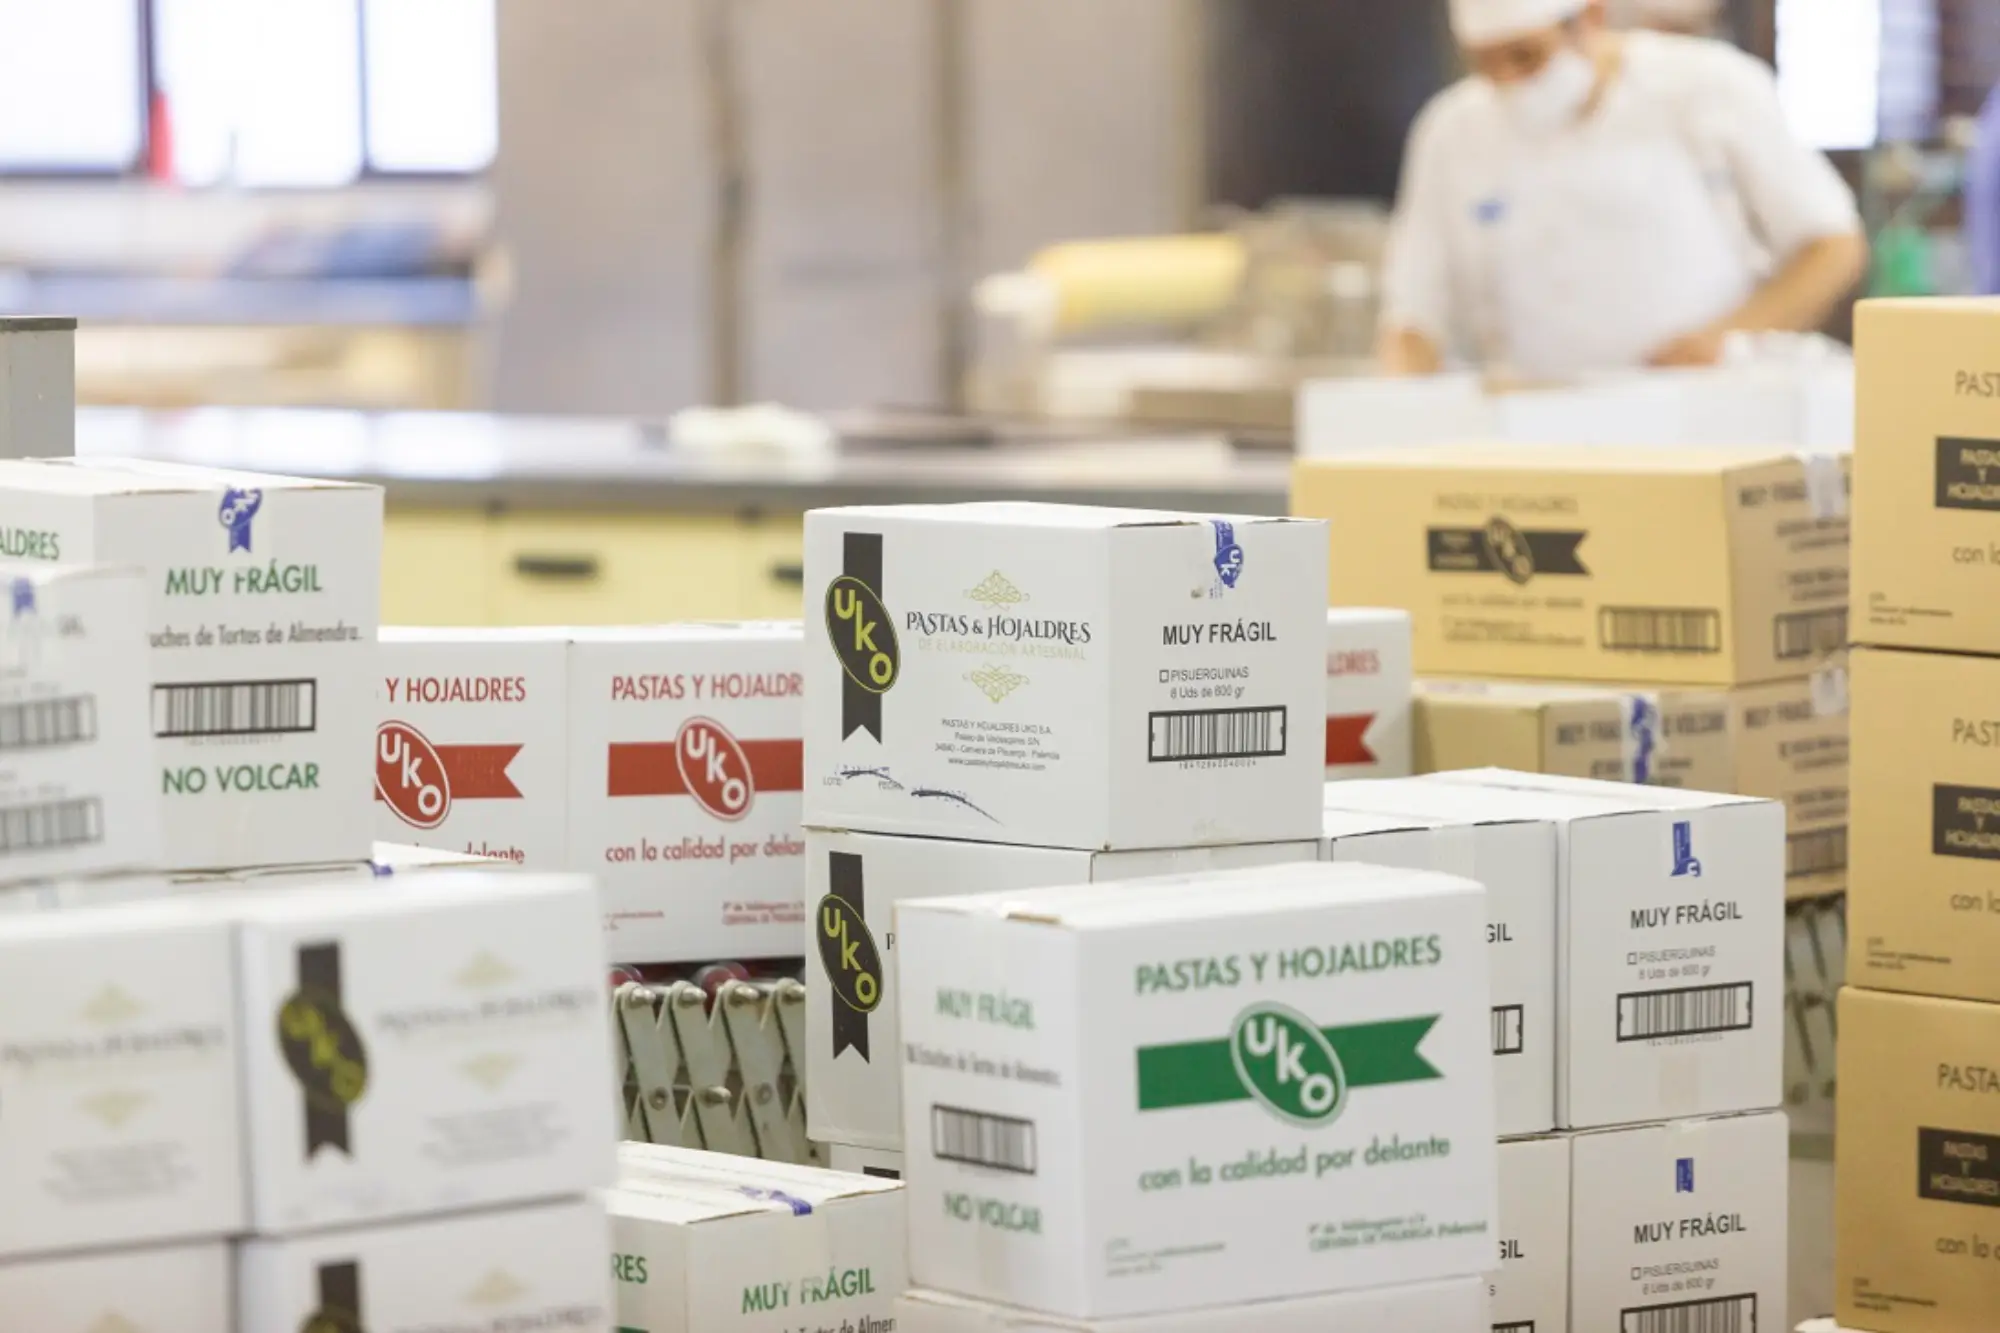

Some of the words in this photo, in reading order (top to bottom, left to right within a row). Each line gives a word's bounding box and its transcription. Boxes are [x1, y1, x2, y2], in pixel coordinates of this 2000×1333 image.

[165, 567, 224, 595] MUY
[234, 558, 322, 594] FRÁGIL
[907, 612, 968, 636] PASTAS
[972, 619, 983, 634] &
[987, 614, 1091, 645] HOJALDRES
[1163, 624, 1204, 645] MUY
[1209, 617, 1277, 643] FRÁGIL
[386, 678, 399, 702] Y
[406, 677, 526, 702] HOJALDRES
[612, 674, 685, 700] PASTAS
[692, 675, 705, 699] Y
[1171, 666, 1249, 681] PISUERGUINAS
[163, 767, 206, 794] NO
[215, 762, 319, 792] VOLCAR
[606, 845, 636, 862] con
[642, 838, 657, 862] la
[663, 836, 725, 860] calidad
[730, 842, 759, 866] por
[1631, 907, 1670, 929] MUY
[1676, 899, 1743, 924] FRÁGIL
[1136, 955, 1241, 994] PASTAS
[1250, 951, 1269, 982] Y
[1278, 935, 1441, 979] HOJALDRES
[1138, 1167, 1181, 1191] con
[1190, 1157, 1212, 1184] la
[1220, 1147, 1307, 1181] calidad
[1316, 1148, 1357, 1178] por
[1364, 1134, 1451, 1165] delante
[1635, 1221, 1674, 1244] MUY
[1680, 1212, 1746, 1238] FRÁGIL
[742, 1282, 791, 1314] MUY
